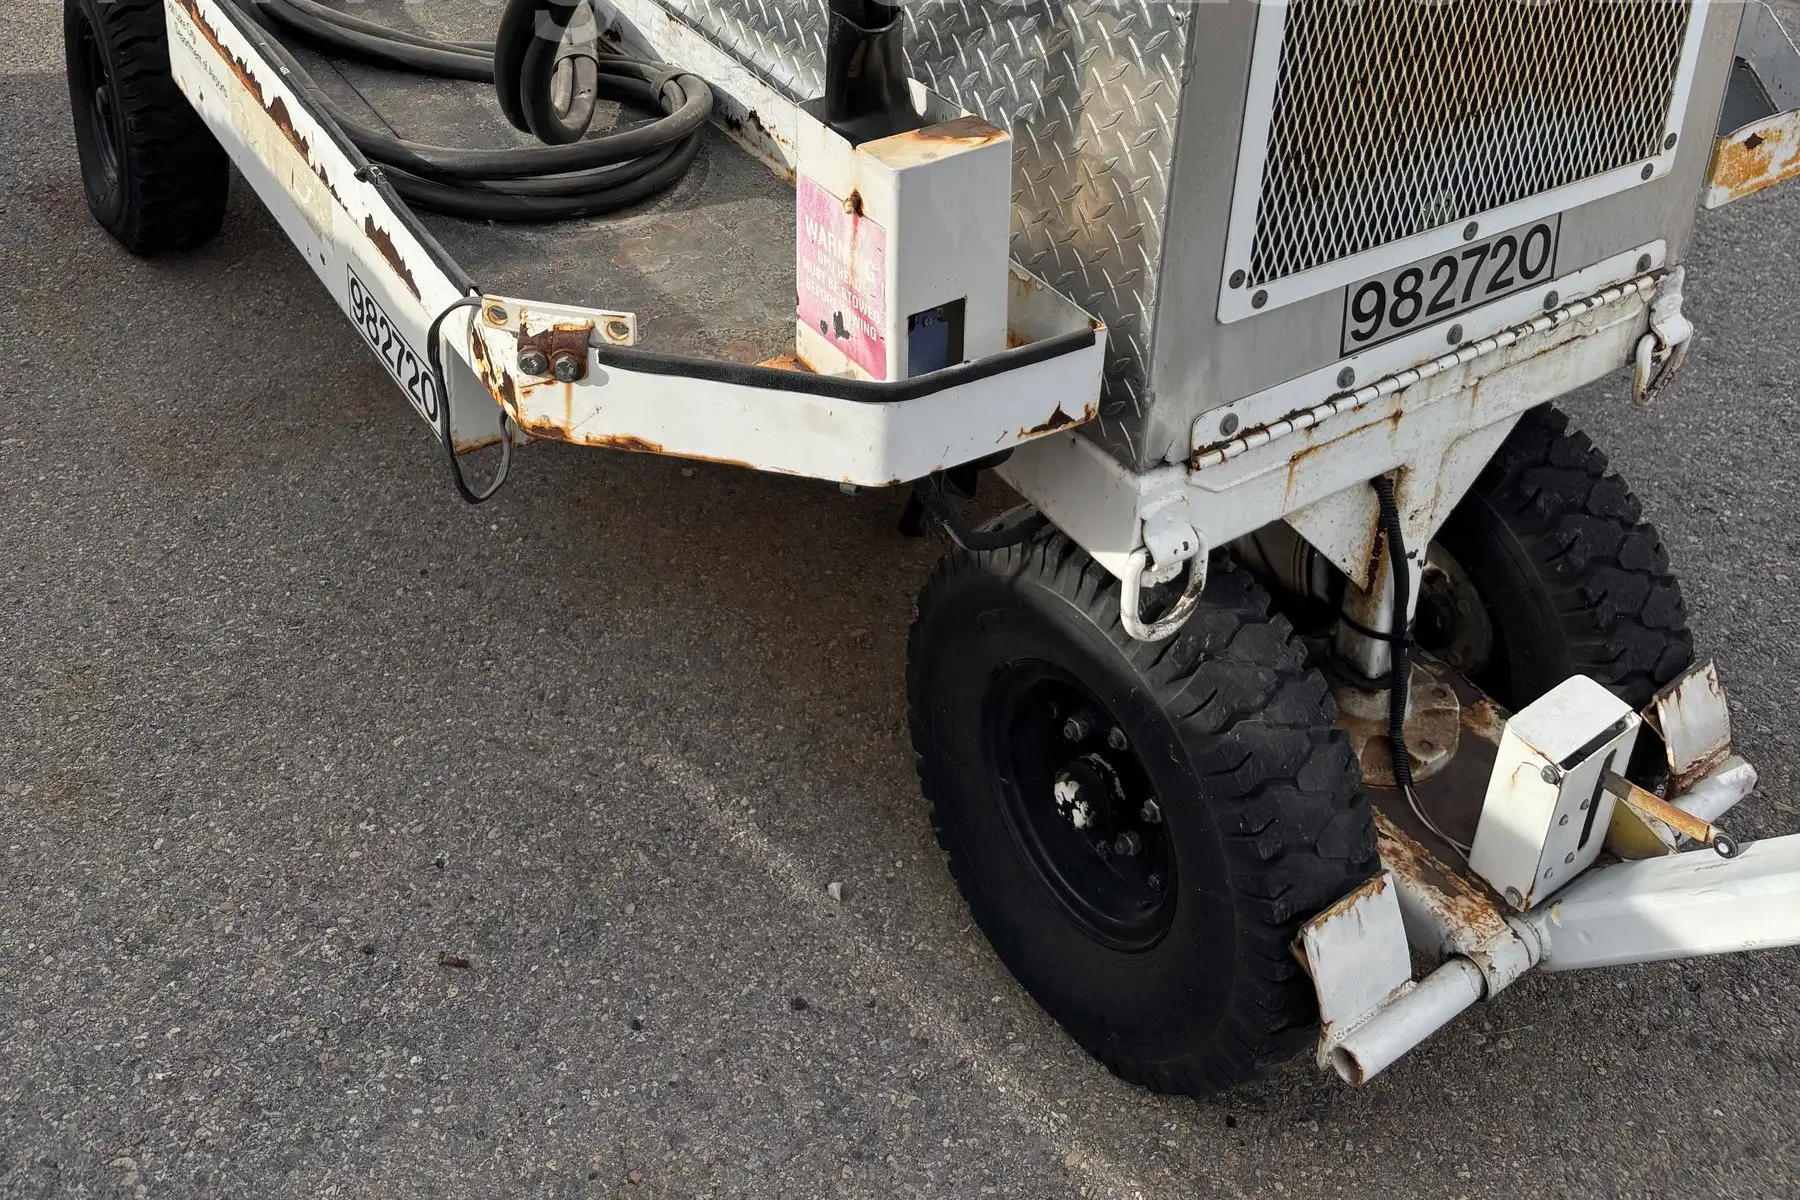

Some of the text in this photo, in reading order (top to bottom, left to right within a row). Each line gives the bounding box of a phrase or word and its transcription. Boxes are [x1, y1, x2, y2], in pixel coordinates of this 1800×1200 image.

[805, 214, 876, 283] WARNG
[1351, 223, 1551, 342] 982720
[806, 278, 837, 310] BEFORE
[828, 275, 839, 295] BE
[841, 286, 880, 324] STOWED
[350, 277, 438, 423] 982720
